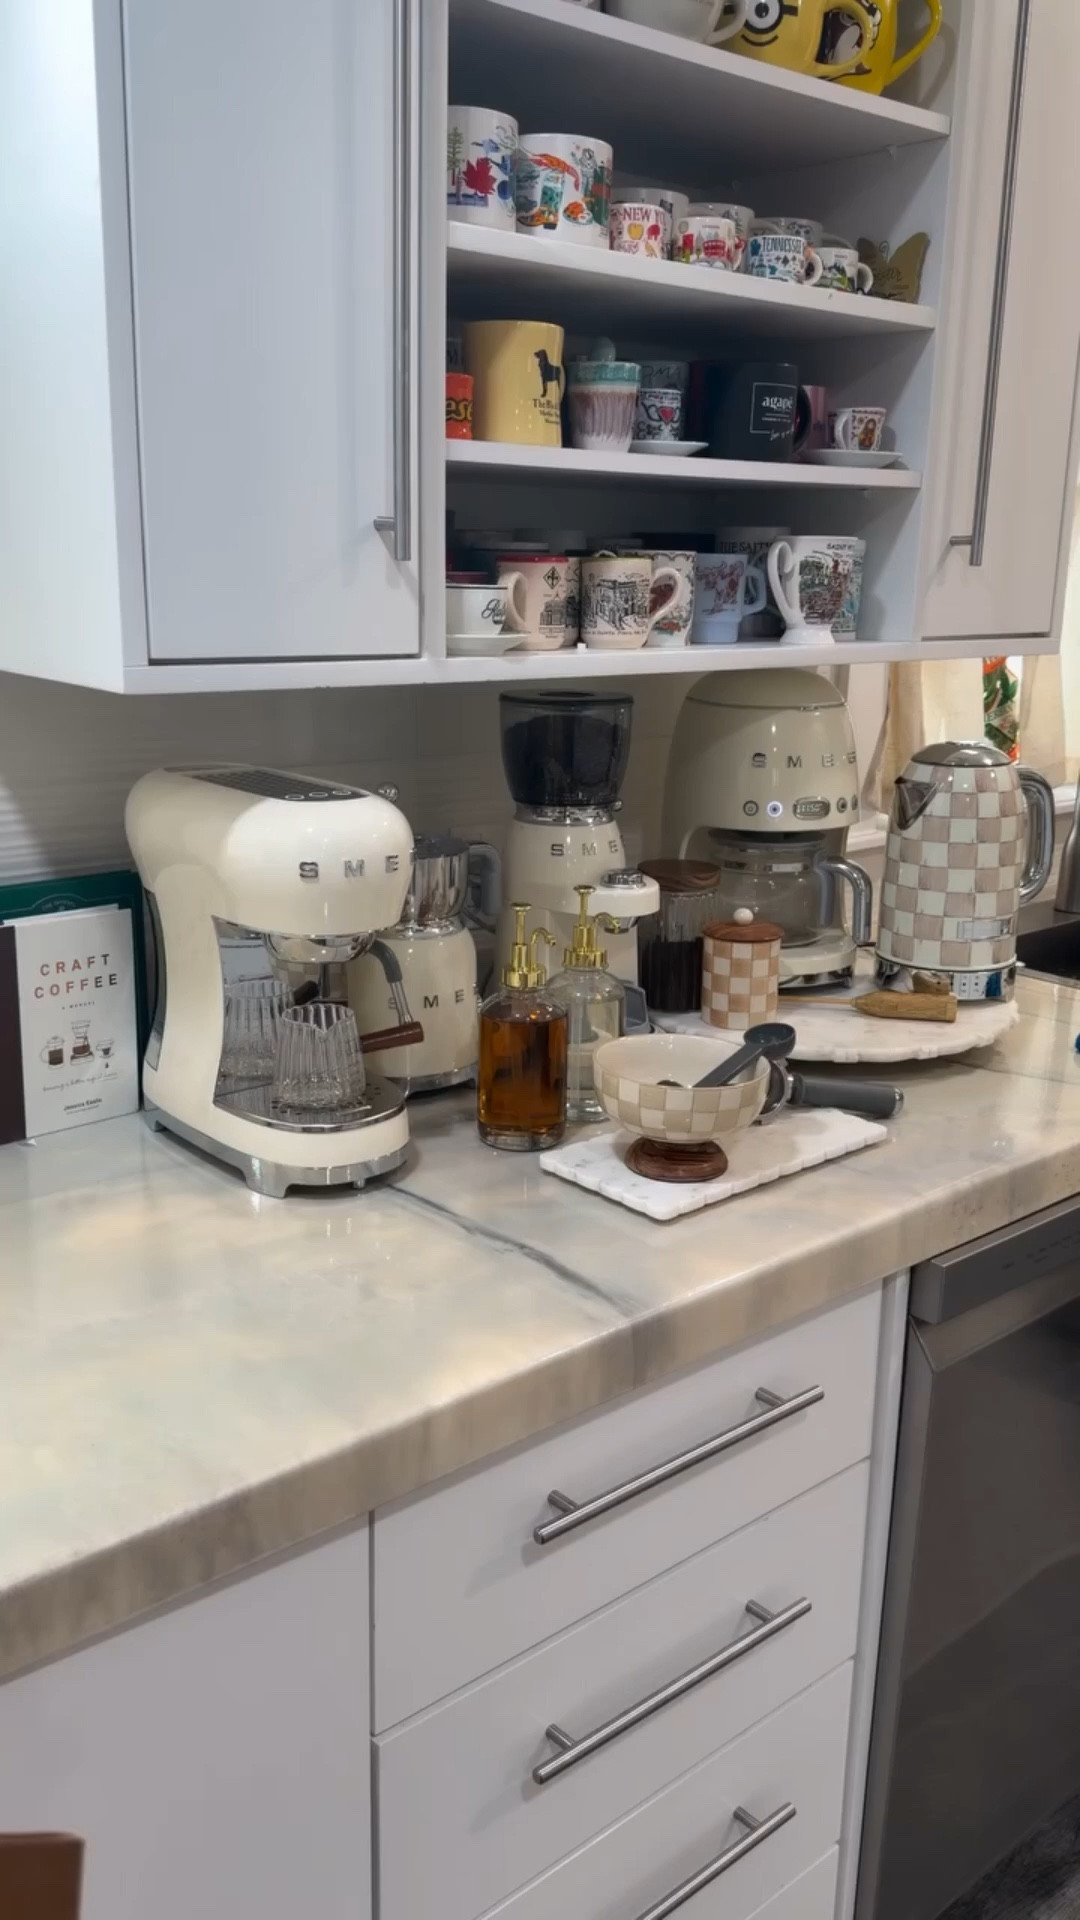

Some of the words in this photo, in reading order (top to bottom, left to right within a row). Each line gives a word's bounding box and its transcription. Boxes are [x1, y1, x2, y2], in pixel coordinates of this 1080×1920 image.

[621, 206, 651, 221] NEW
[551, 835, 623, 857] SME
[298, 852, 414, 881] SME
[40, 953, 110, 977] CRAFT
[34, 973, 118, 999] COFFEE
[388, 988, 477, 1010] SME
